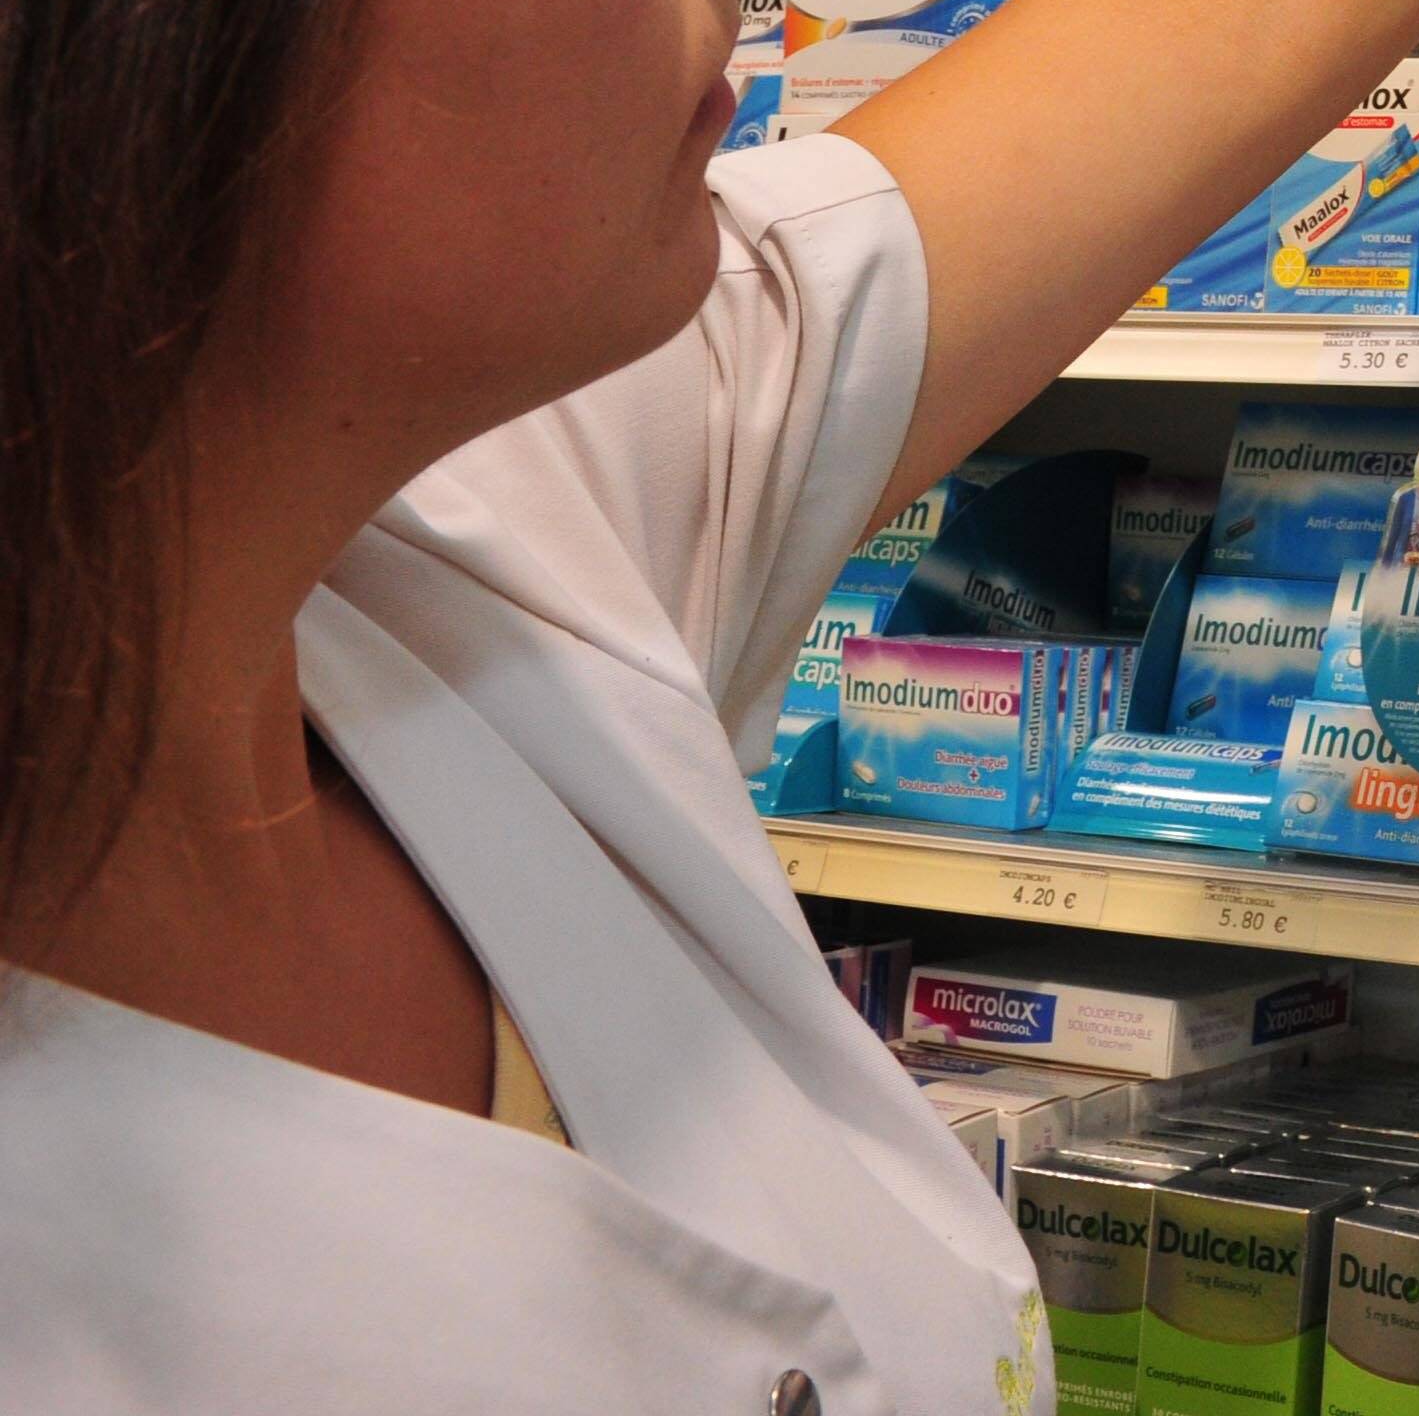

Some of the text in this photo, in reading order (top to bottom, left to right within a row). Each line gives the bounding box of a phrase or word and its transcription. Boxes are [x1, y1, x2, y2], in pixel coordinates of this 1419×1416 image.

[900, 33, 944, 48] ADULTE
[1339, 353, 1408, 369] 5.30 €
[1218, 908, 1287, 934] 5.80 €
[933, 986, 1038, 1025] microlax
[969, 1017, 1031, 1038] MACROGOL
[1159, 1220, 1297, 1277] Dulcolax
